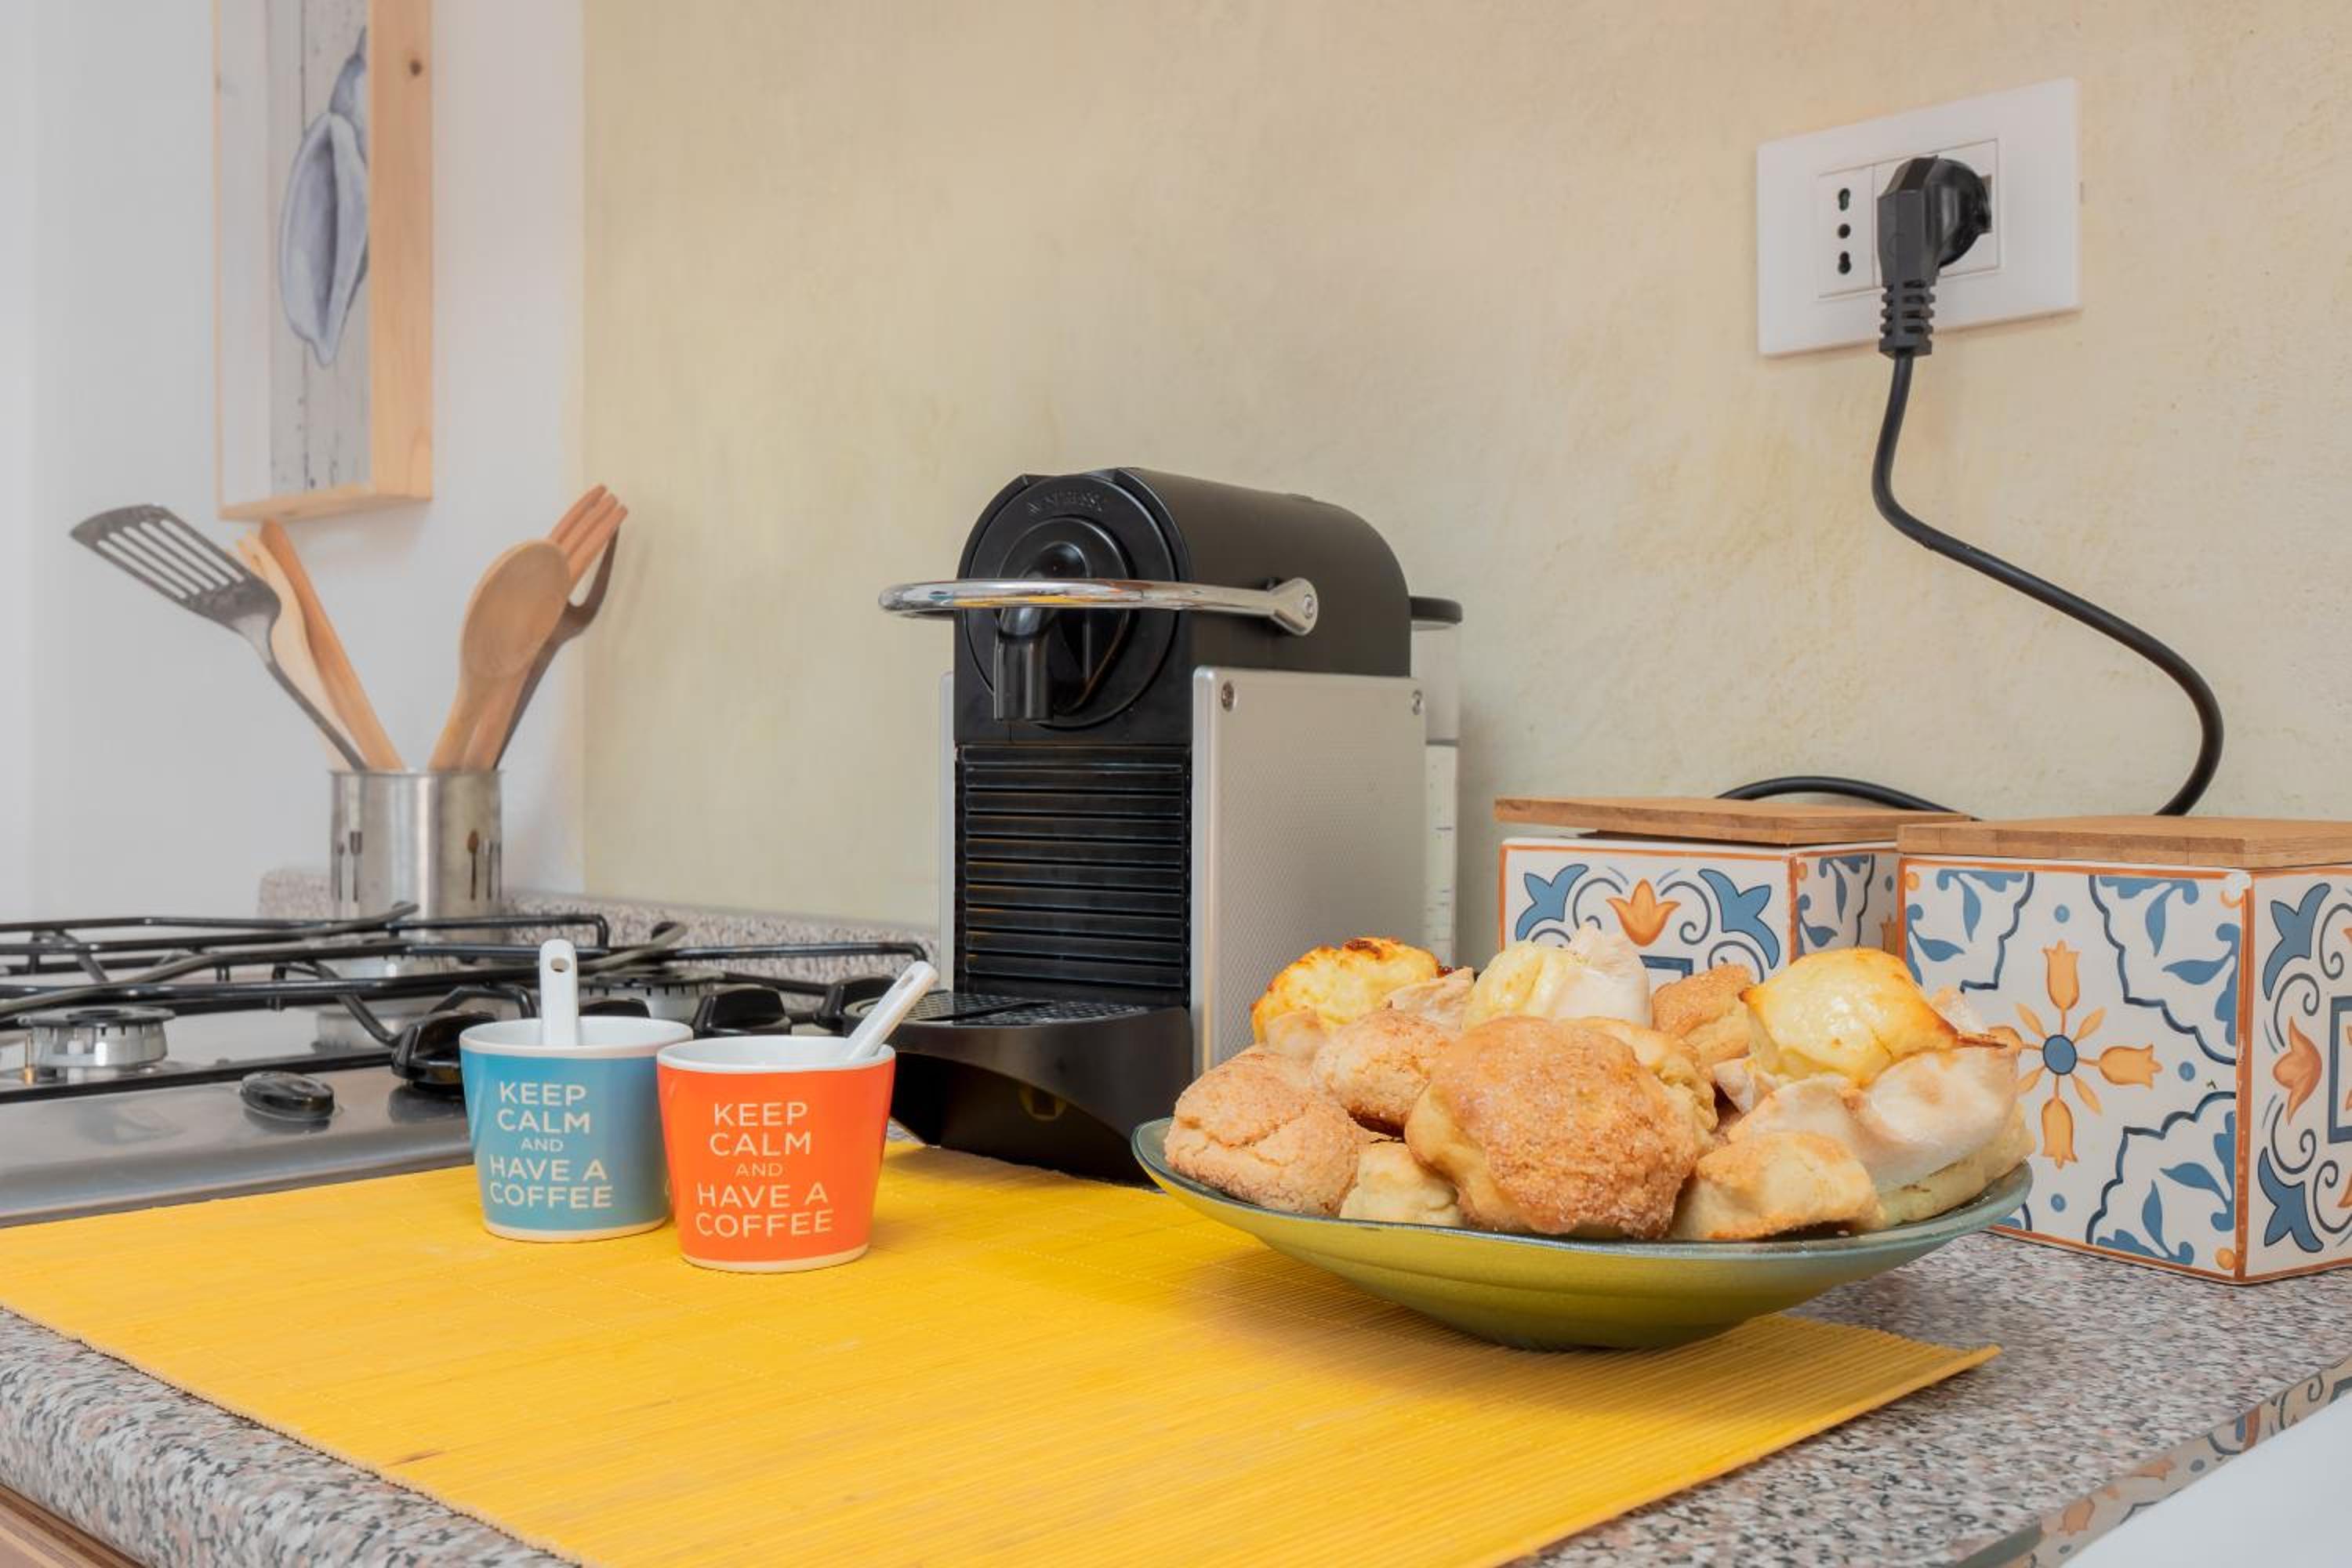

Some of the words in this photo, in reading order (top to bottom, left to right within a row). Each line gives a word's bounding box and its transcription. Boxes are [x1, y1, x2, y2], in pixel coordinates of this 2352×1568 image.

[499, 1080, 587, 1106] KEEP
[497, 1108, 590, 1134] CALM
[713, 1101, 809, 1127] KEEP
[520, 1137, 564, 1152] AND
[709, 1131, 811, 1157] CALM
[489, 1153, 571, 1181] HAVE
[582, 1159, 608, 1182] A
[735, 1162, 784, 1178] AND
[489, 1181, 614, 1210] COFFEE
[696, 1181, 791, 1209] HAVE
[804, 1181, 829, 1206] A
[695, 1208, 834, 1238] COFFEE
